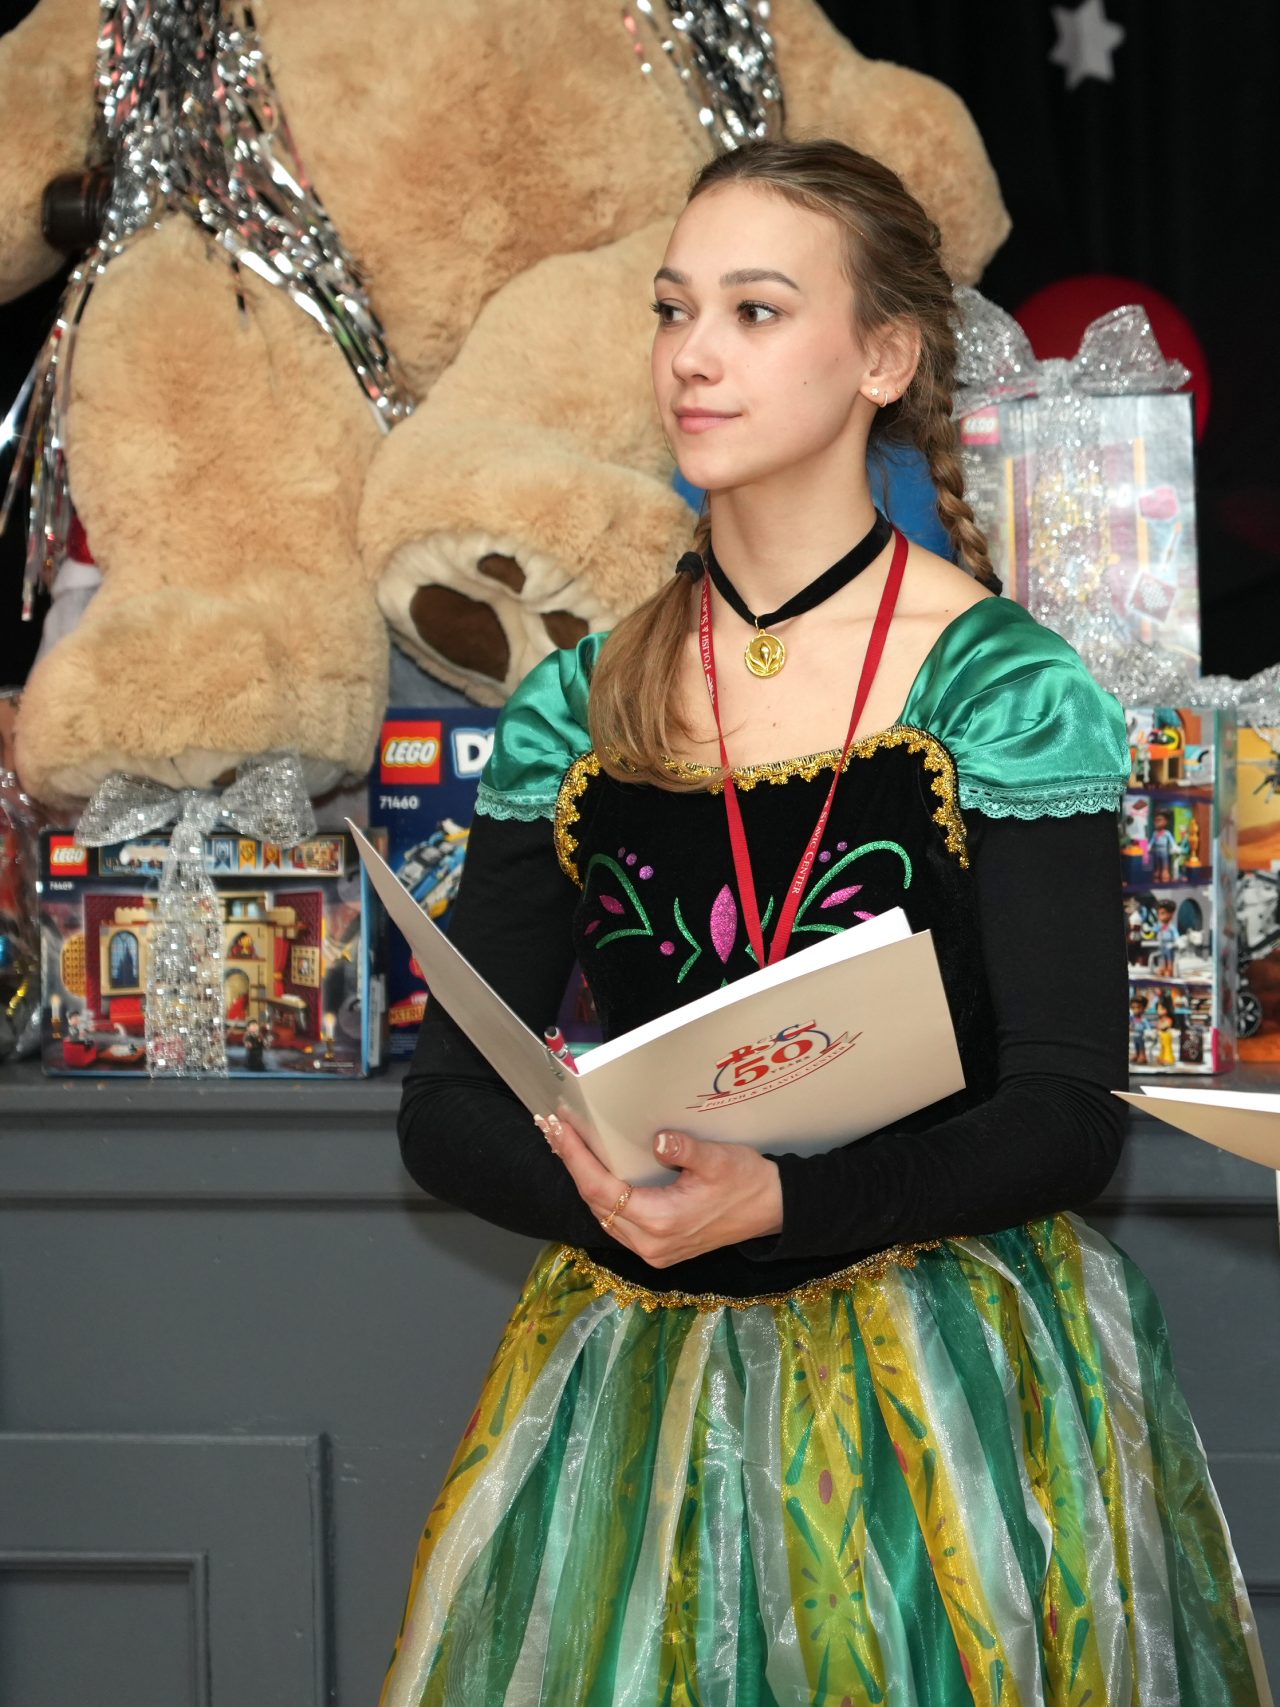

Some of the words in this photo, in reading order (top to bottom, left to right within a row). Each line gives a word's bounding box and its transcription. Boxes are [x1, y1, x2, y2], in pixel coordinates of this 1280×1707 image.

[702, 635, 712, 671] POLISH
[382, 737, 438, 767] LEGO
[451, 728, 496, 778] D
[380, 796, 419, 809] 71460
[51, 846, 87, 864] LEGO
[792, 852, 814, 894] CENTER
[733, 1039, 813, 1087] 50
